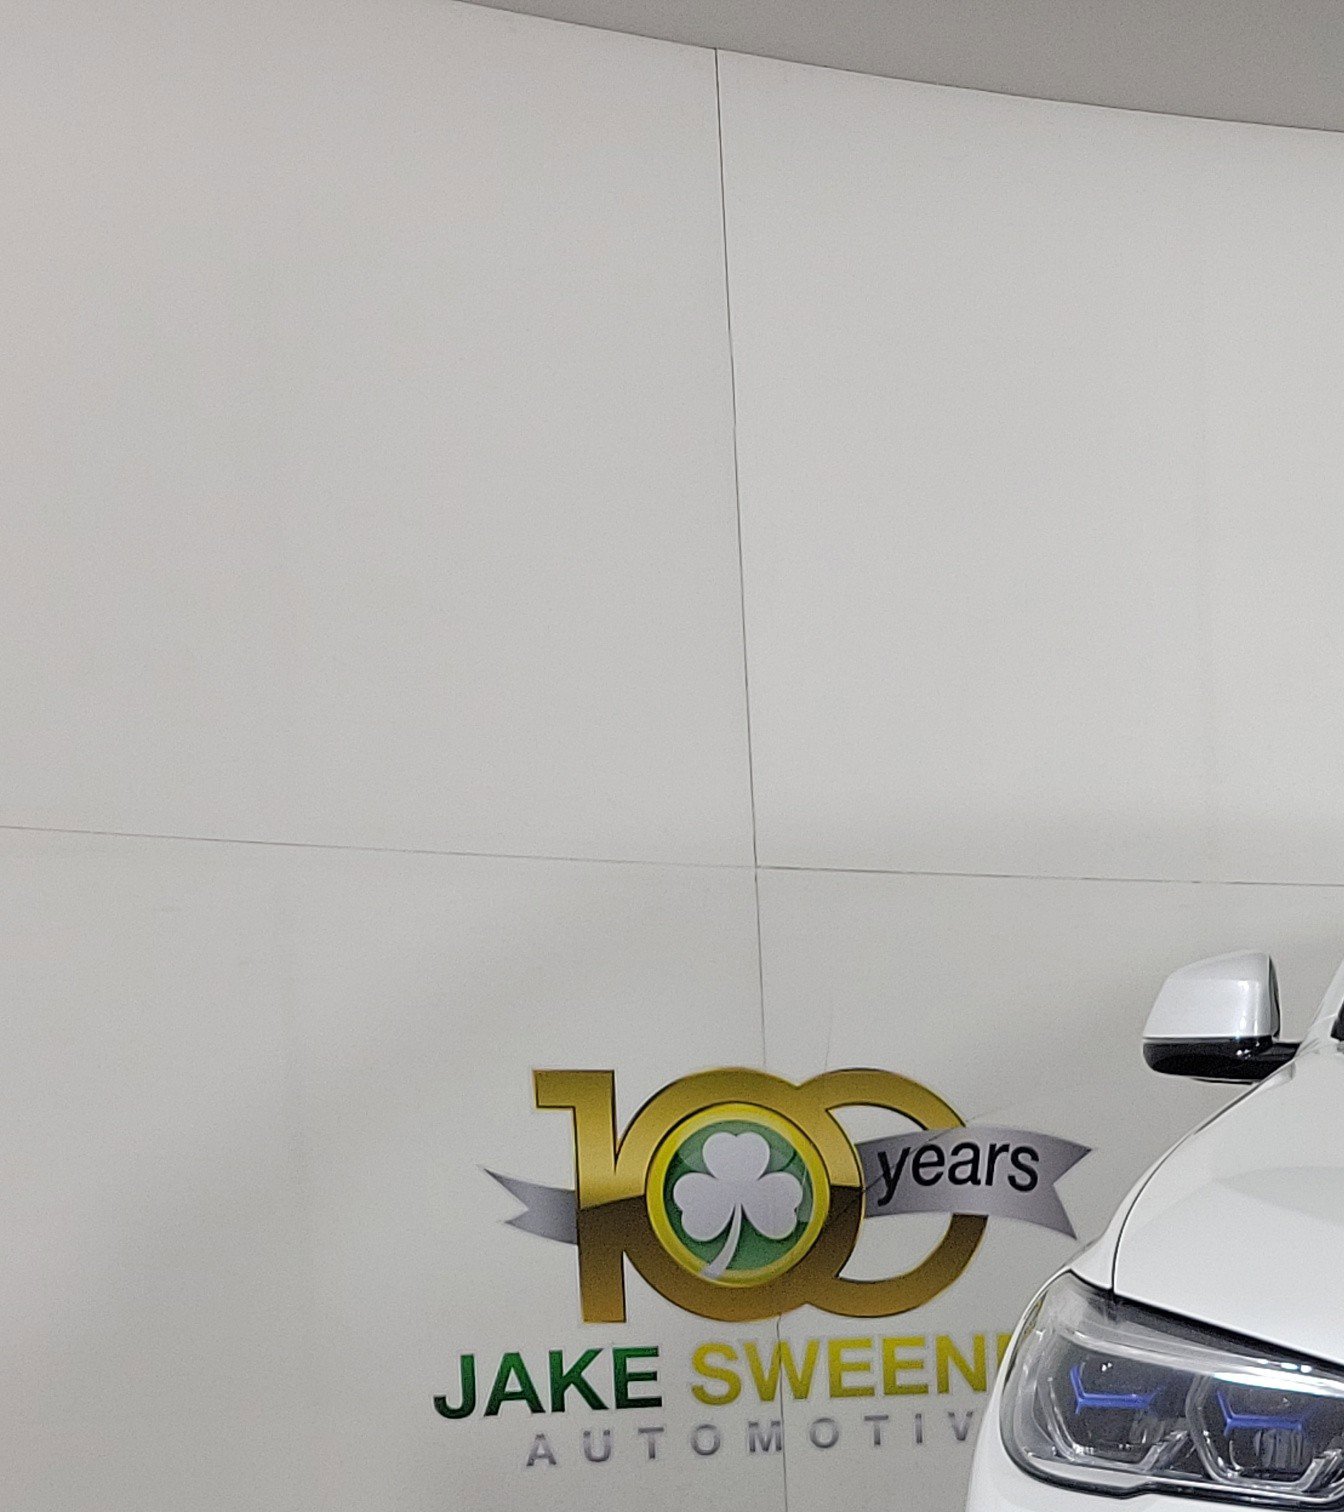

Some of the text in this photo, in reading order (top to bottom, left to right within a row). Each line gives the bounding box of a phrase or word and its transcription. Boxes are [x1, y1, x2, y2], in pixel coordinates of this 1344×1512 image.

[534, 1067, 1040, 1323] 100 years
[433, 1345, 662, 1418] JAKE
